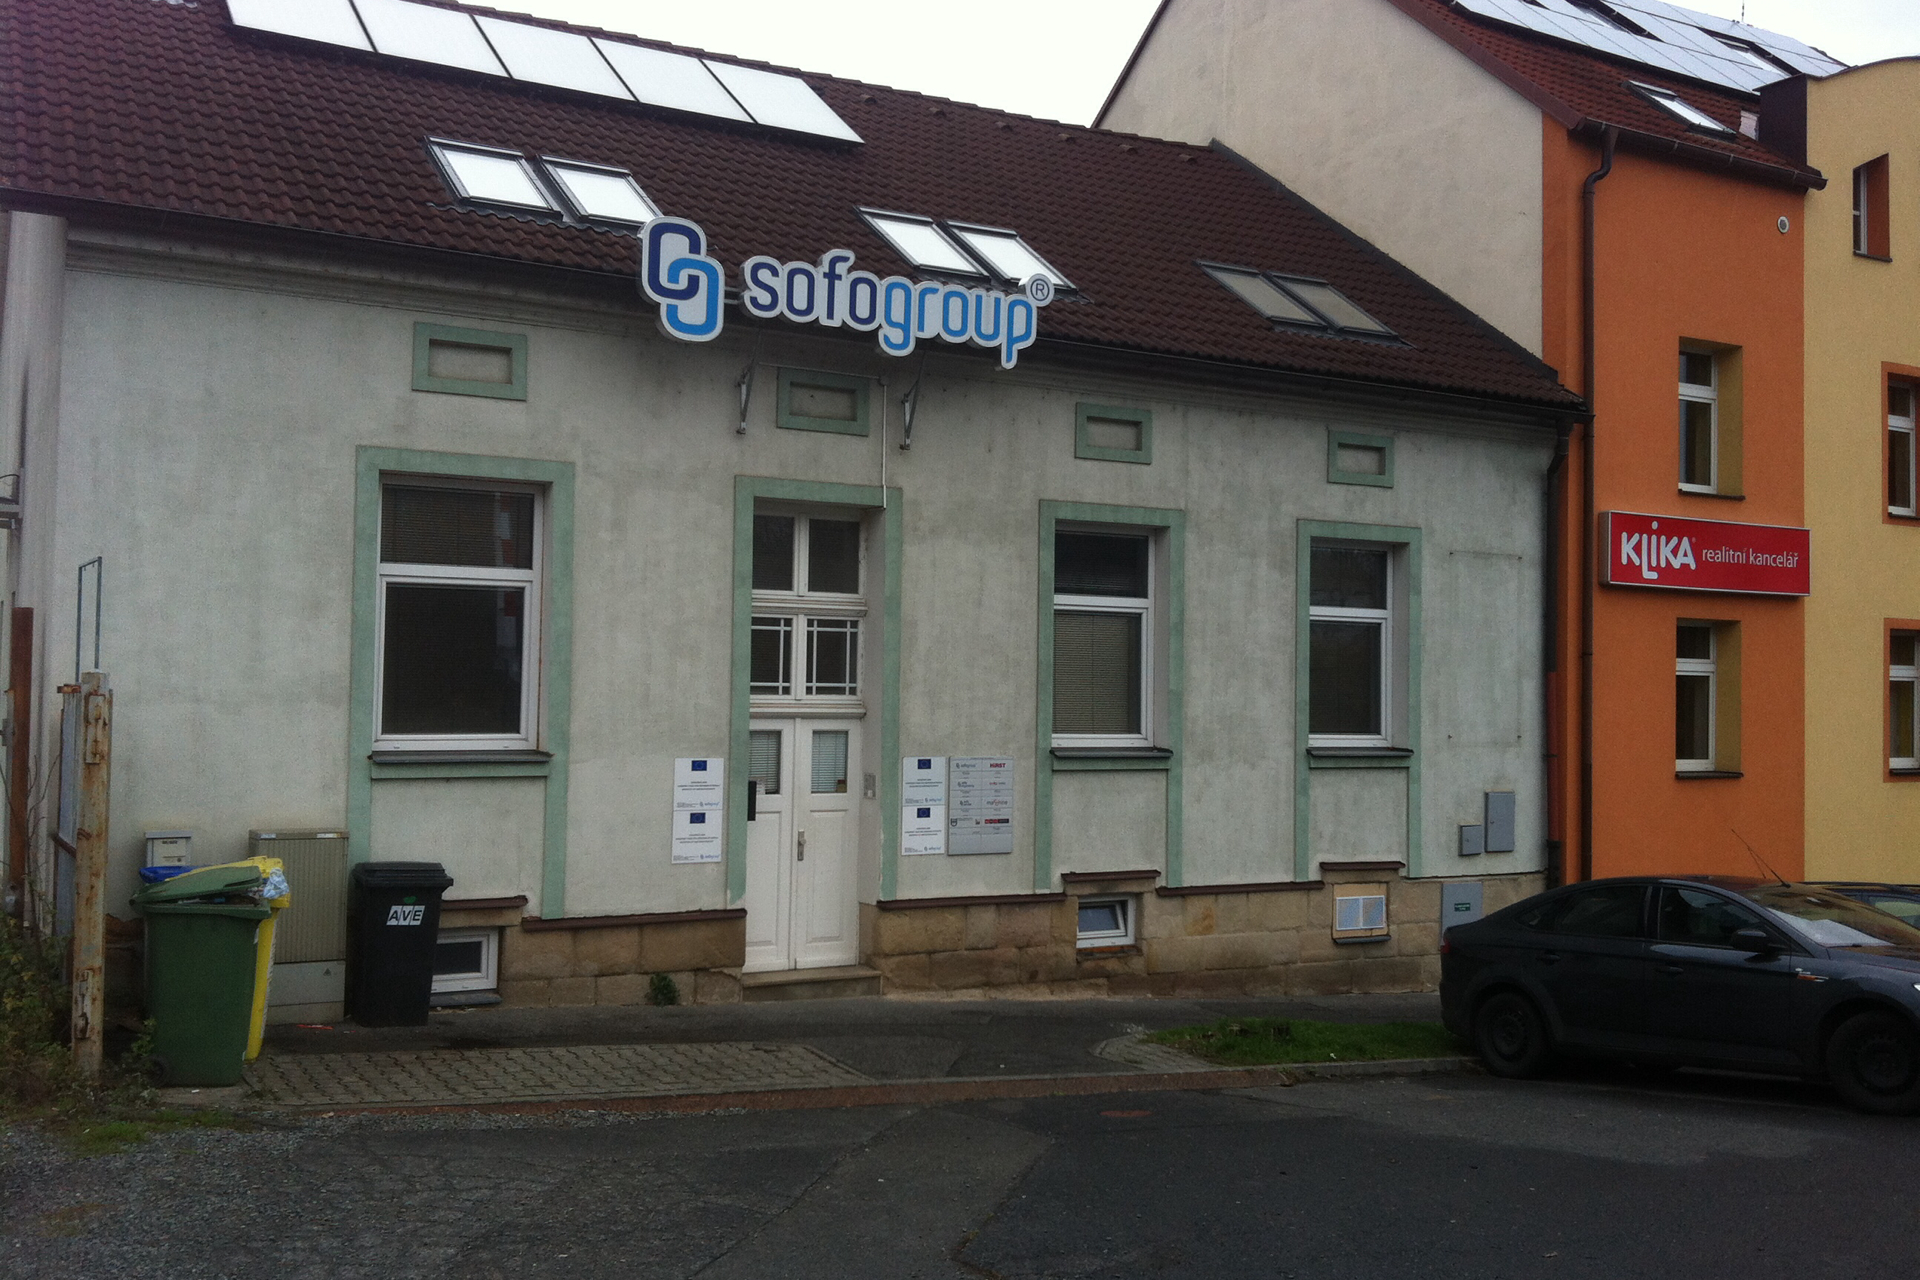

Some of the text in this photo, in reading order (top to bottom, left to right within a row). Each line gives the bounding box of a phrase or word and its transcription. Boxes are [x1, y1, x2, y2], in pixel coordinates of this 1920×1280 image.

[1702, 545, 1747, 565] realitní
[1749, 548, 1799, 569] kancelář
[388, 909, 423, 922] AVE
